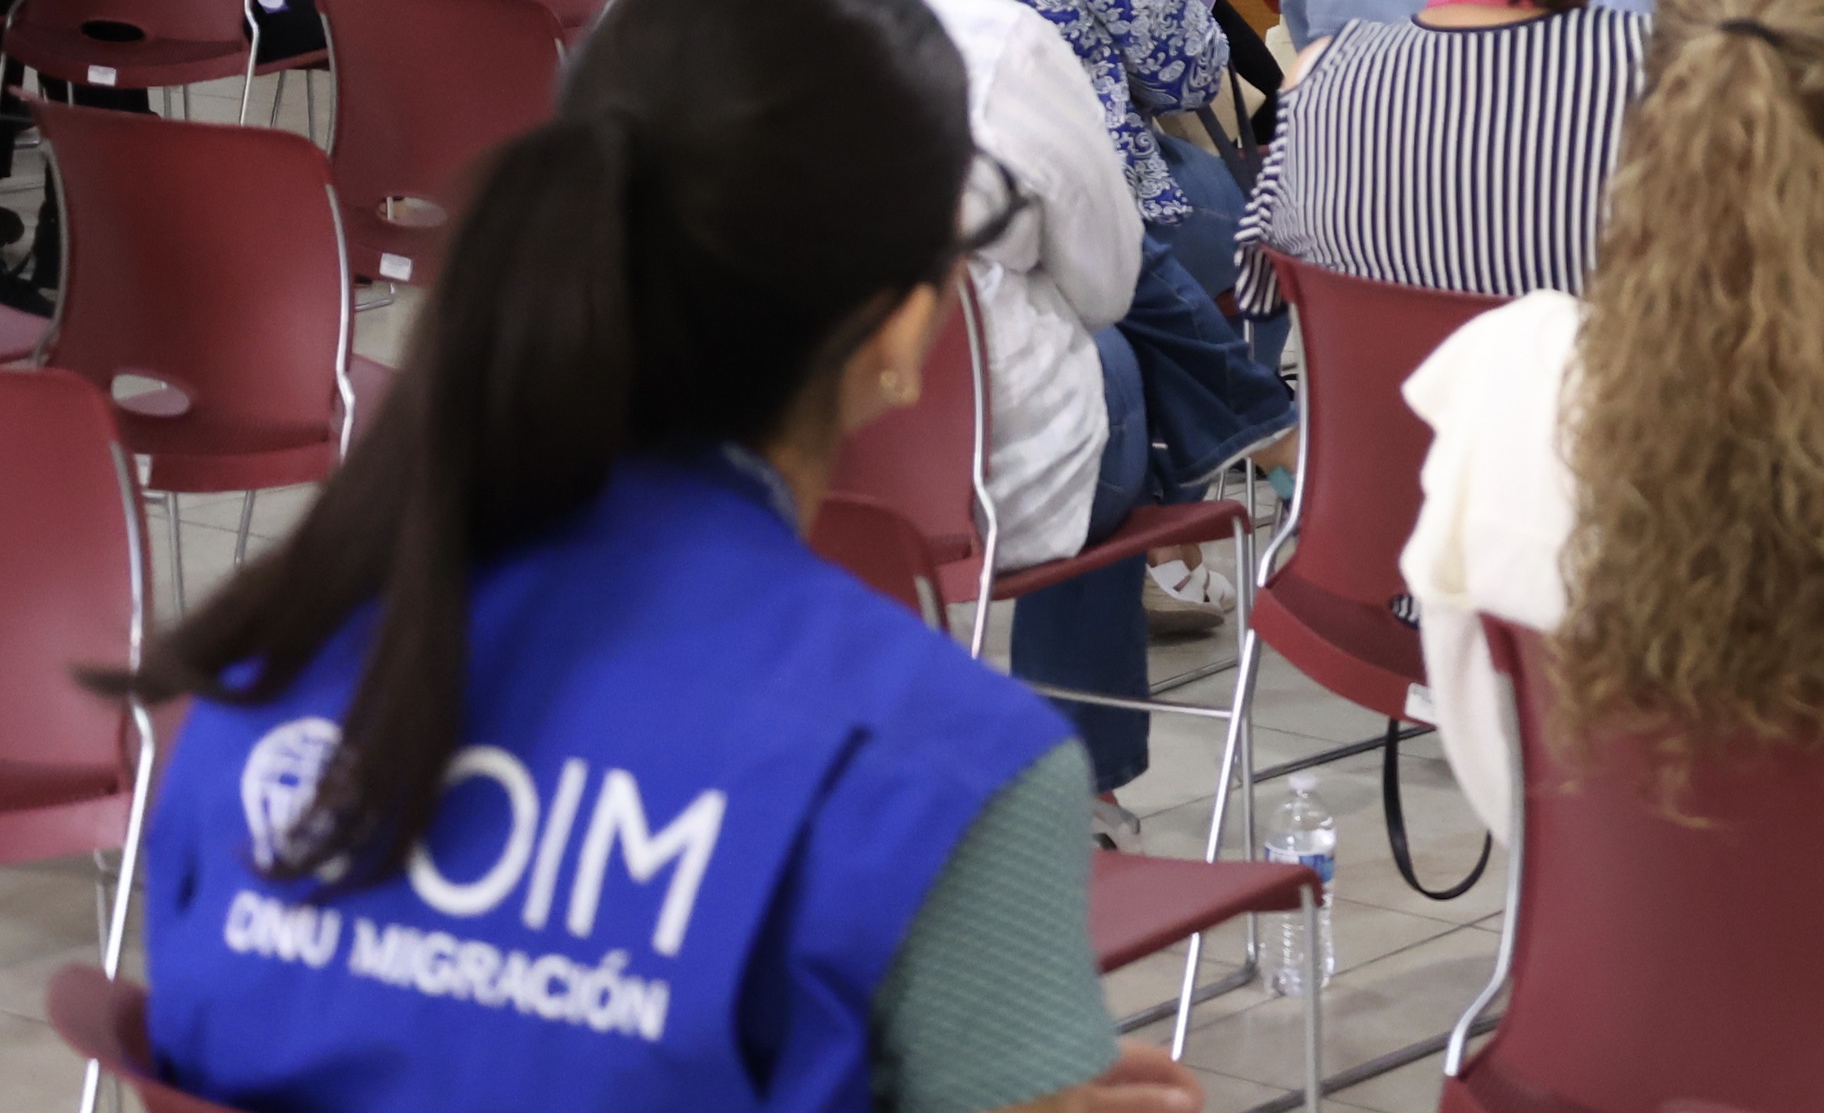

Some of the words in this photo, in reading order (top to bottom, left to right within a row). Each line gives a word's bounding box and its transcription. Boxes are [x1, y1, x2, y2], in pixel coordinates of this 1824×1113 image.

[407, 744, 727, 957] OIM
[224, 890, 342, 968] ONU
[348, 916, 671, 1041] MIGRACIÓN
